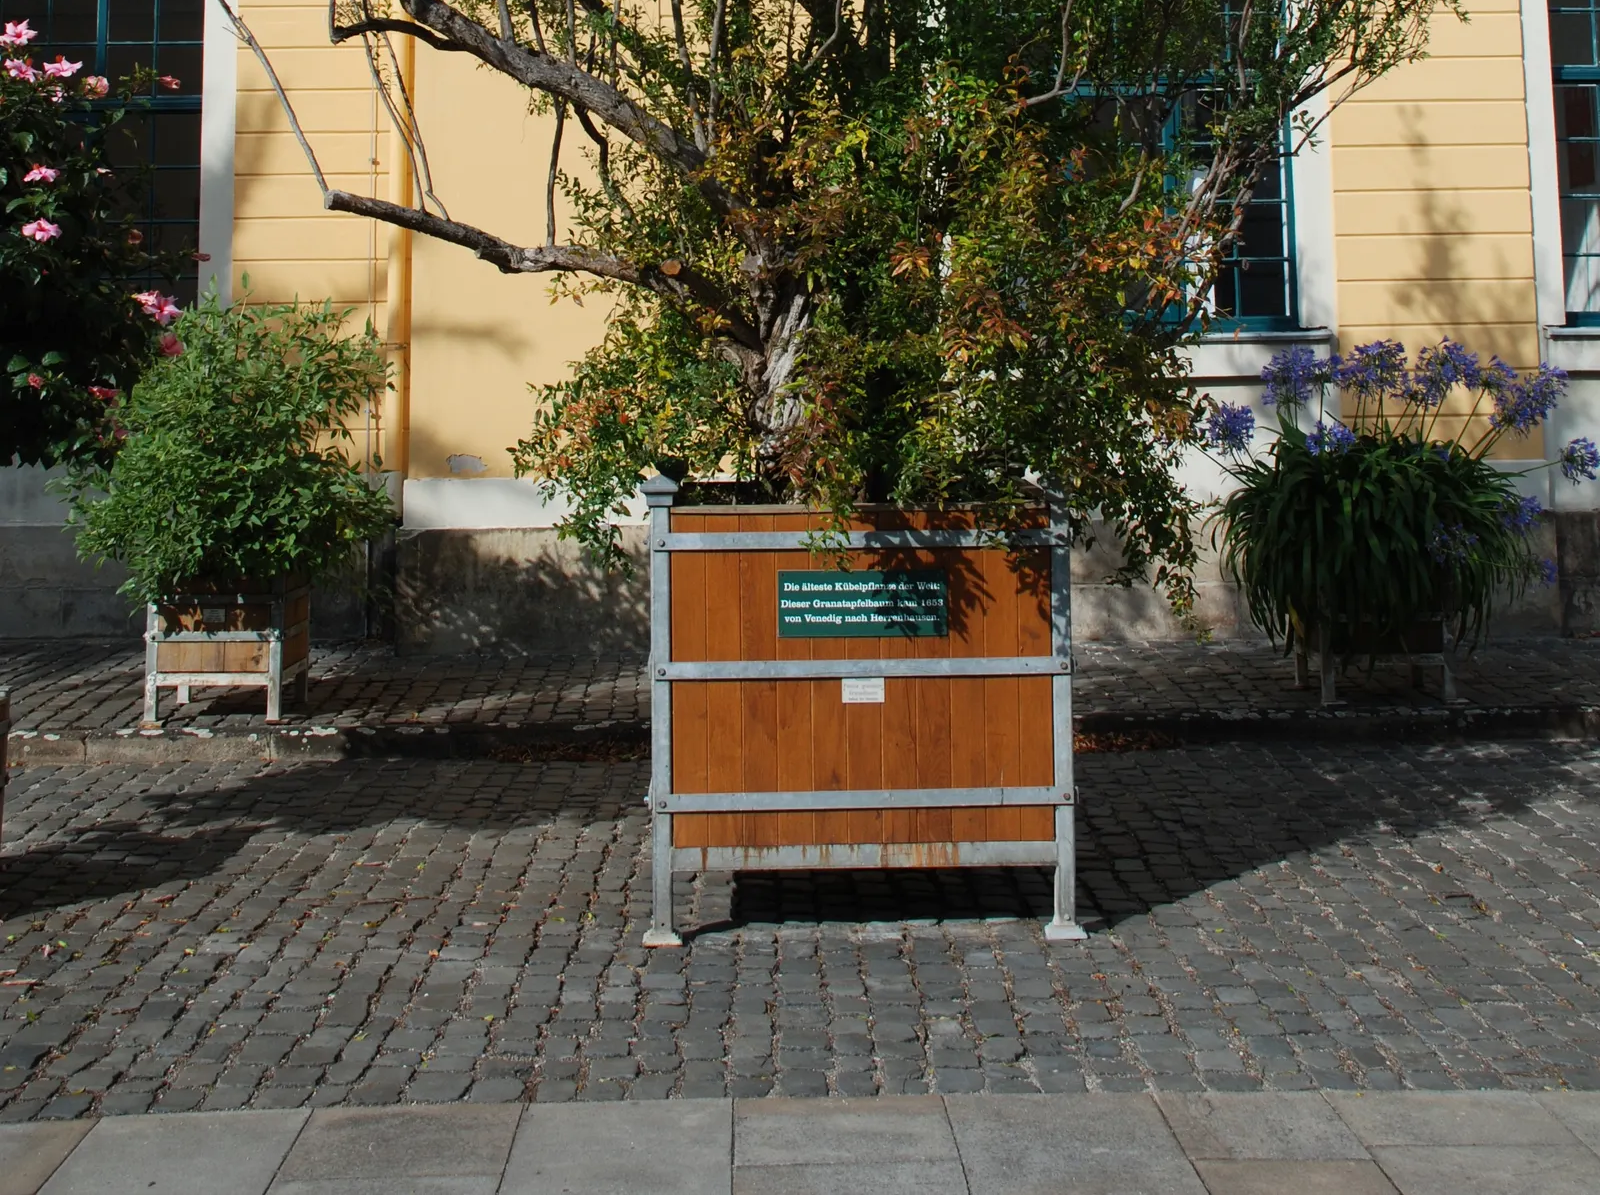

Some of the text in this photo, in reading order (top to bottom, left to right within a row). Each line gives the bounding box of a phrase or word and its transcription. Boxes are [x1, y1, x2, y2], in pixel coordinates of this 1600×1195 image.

[784, 581, 941, 593] Die älteste Kübelpflanze der Welt:
[781, 598, 945, 610] Dieser Granatapfelbaum kam 1653
[784, 613, 941, 625] von Venedig nach Herrenhausen.
